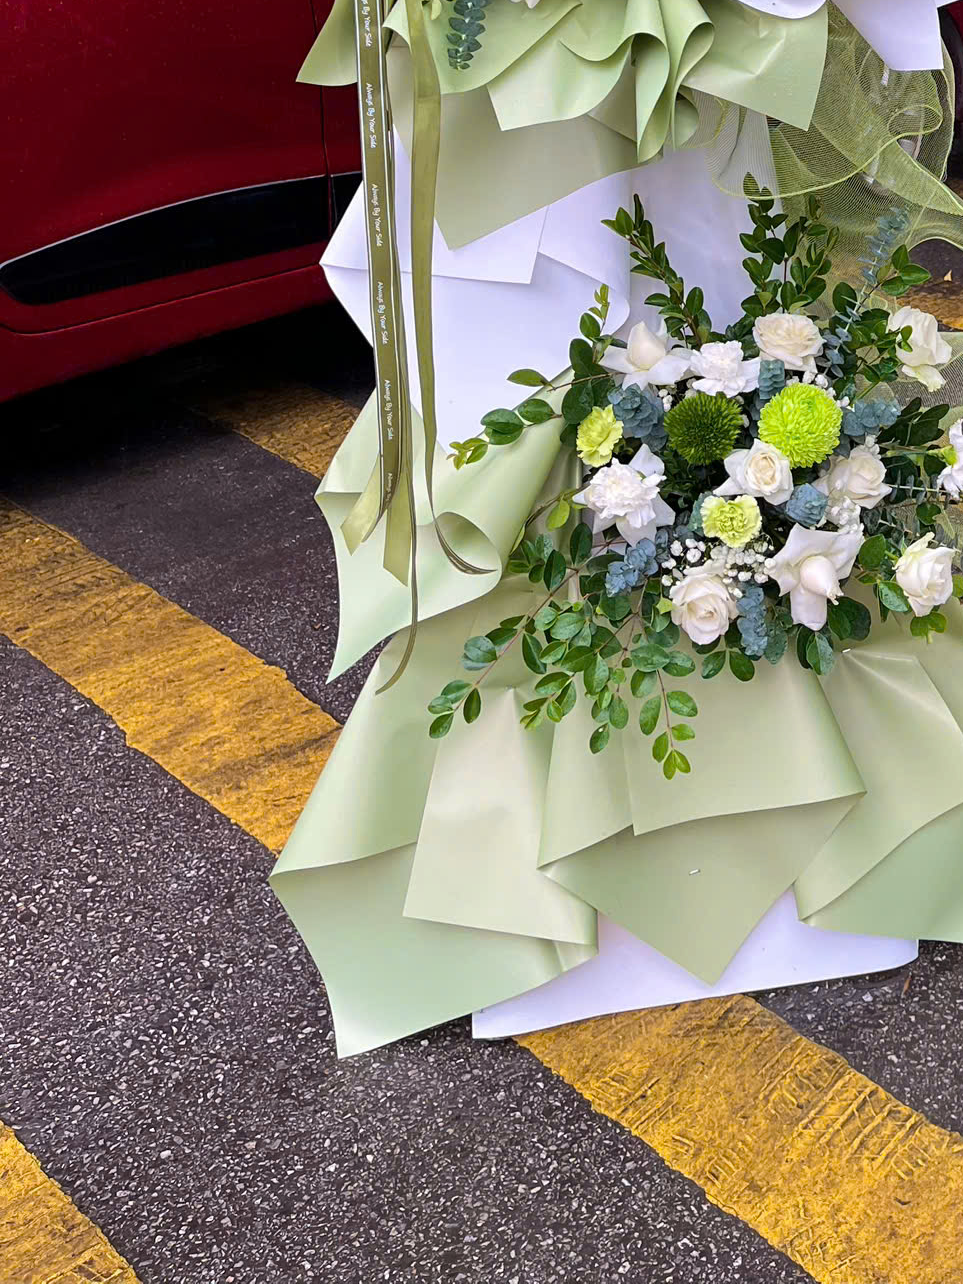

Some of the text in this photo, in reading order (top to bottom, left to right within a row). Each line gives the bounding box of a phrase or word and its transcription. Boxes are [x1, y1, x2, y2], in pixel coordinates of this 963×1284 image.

[362, 5, 370, 16] By
[364, 34, 372, 48] Side
[366, 82, 374, 106] Always
[366, 106, 375, 116] By
[371, 183, 379, 206] Always
[372, 206, 380, 216] By
[373, 218, 382, 232] Your
[378, 304, 386, 314] By
[384, 402, 392, 411] By
